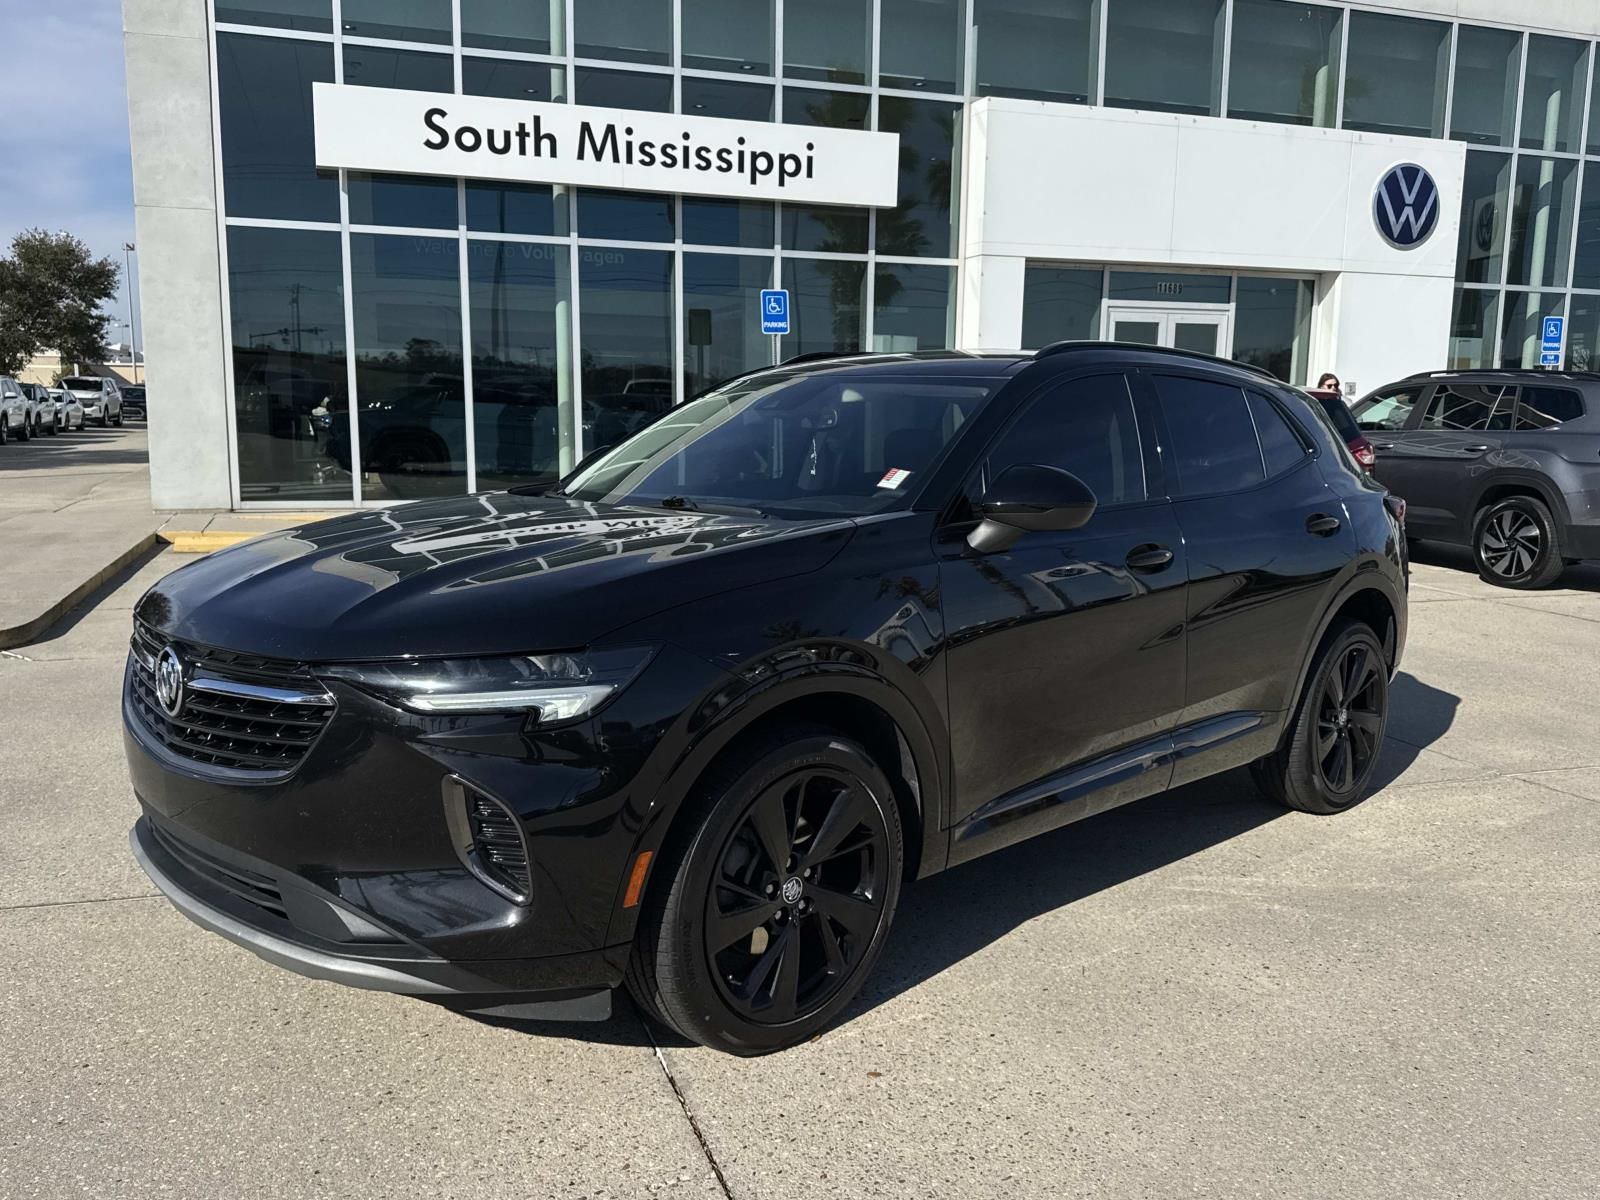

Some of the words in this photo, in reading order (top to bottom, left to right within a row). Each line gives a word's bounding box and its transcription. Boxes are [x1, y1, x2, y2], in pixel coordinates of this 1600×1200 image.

[423, 107, 558, 159] South
[577, 121, 815, 188] Mississippi
[1376, 164, 1438, 245] VW
[415, 238, 496, 257] Welcme
